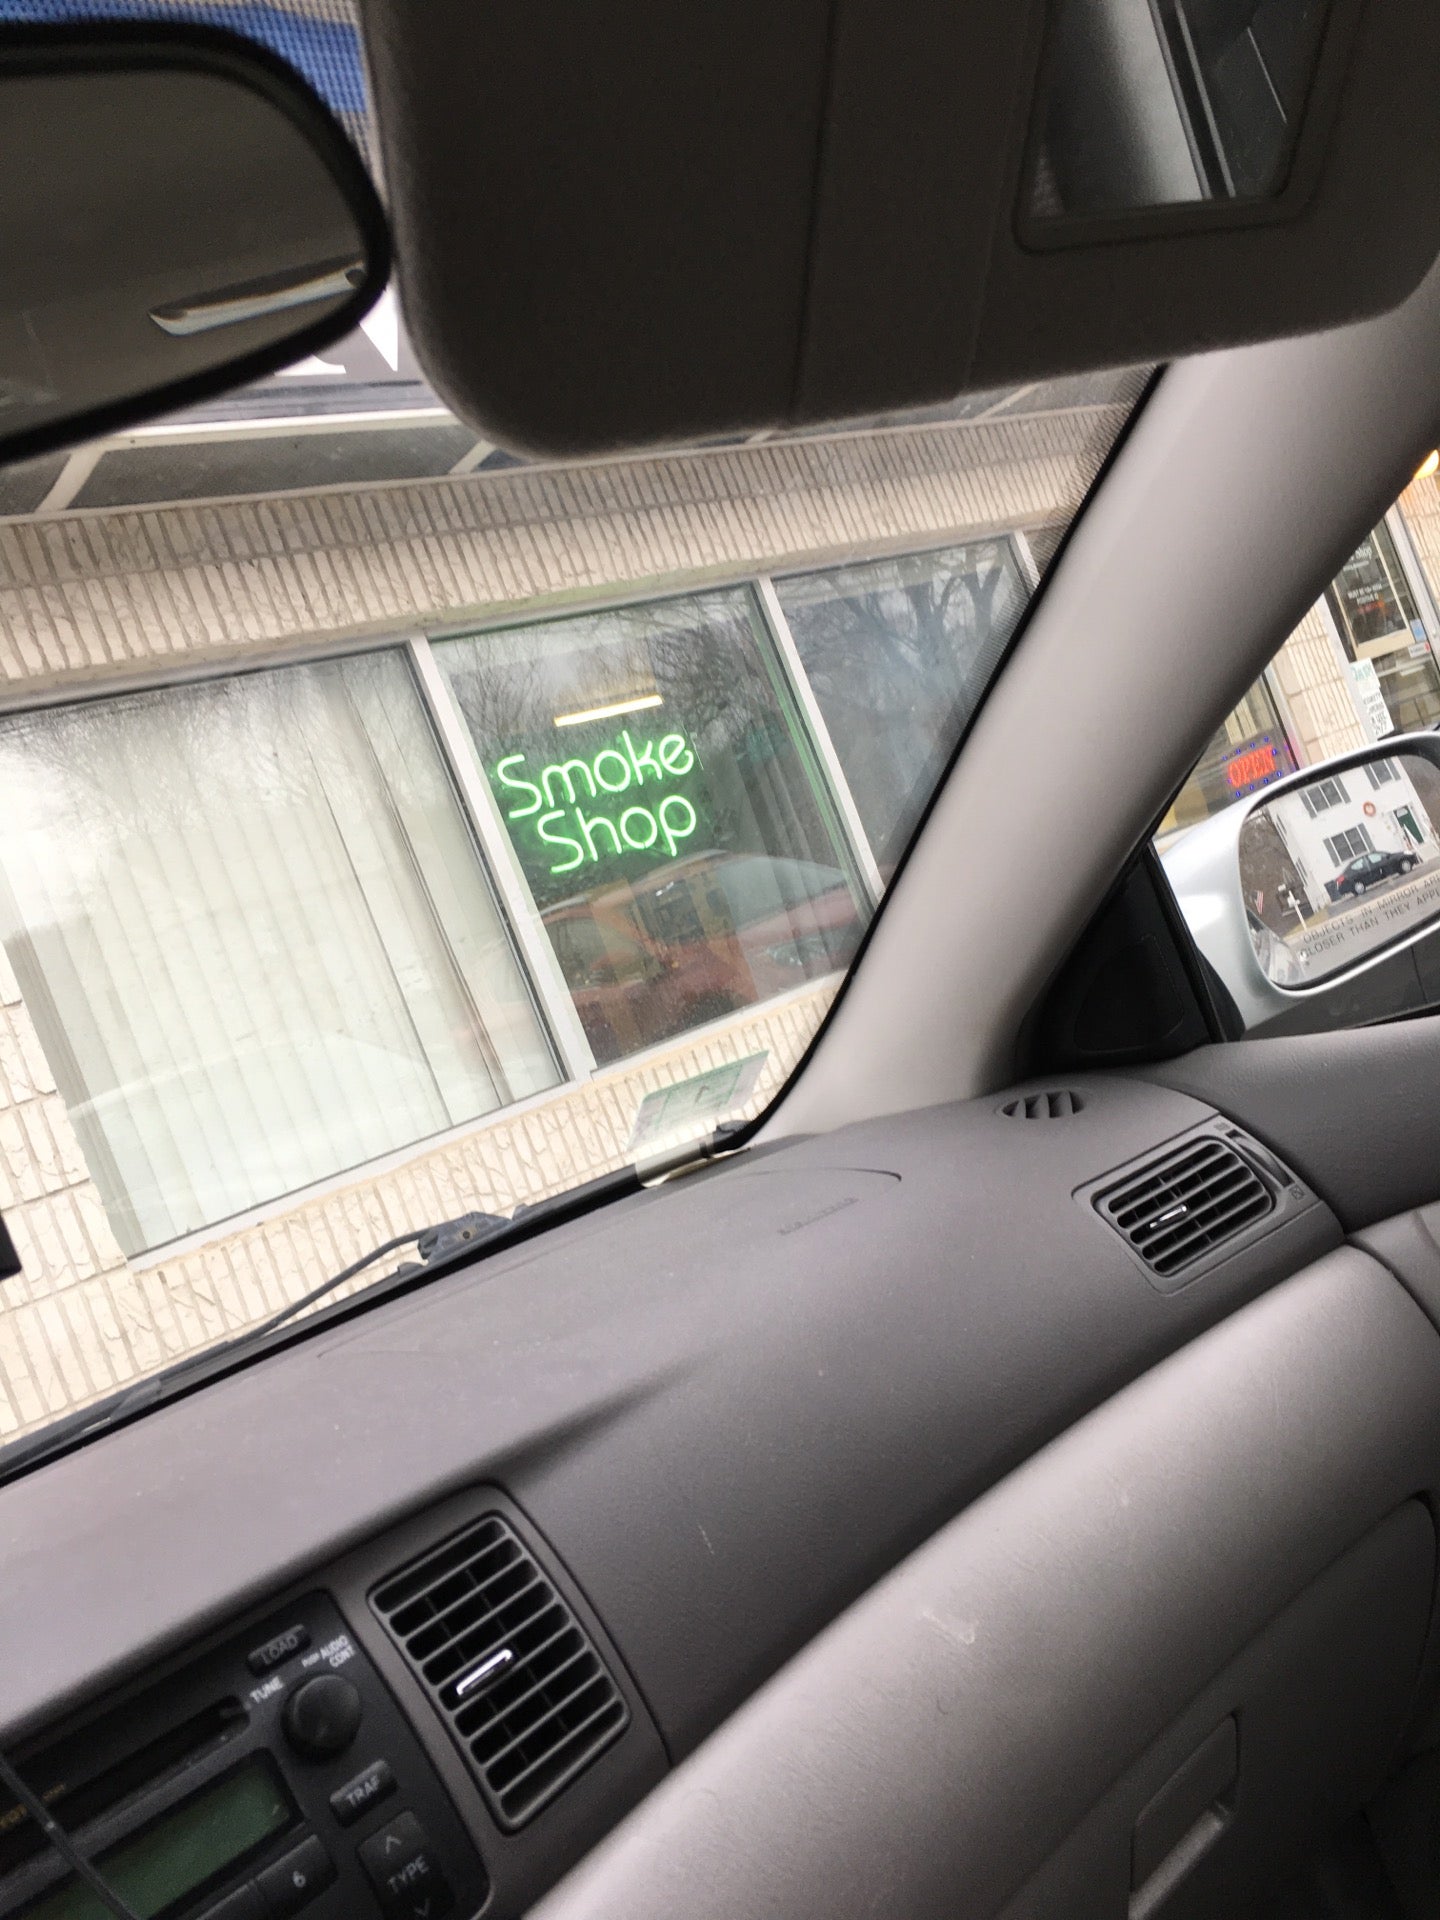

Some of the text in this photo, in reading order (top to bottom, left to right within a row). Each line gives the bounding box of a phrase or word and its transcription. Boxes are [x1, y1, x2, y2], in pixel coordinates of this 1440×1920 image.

[497, 730, 694, 819] Smoke
[1228, 744, 1276, 788] OPEN
[537, 795, 696, 873] Shop
[1301, 933, 1345, 958] CLOSER
[1350, 915, 1379, 937] THAN
[1384, 901, 1411, 920] THEY
[1303, 914, 1353, 943] OBJECTS
[1361, 906, 1373, 918] IN
[1377, 884, 1419, 910] MIRROR
[260, 1633, 298, 1665] LOAD
[320, 1634, 349, 1659] AUDIO
[249, 1675, 284, 1703] TUNE
[346, 1775, 380, 1806] TRAF
[292, 1870, 307, 1888] 6
[387, 1854, 429, 1894] TYPE
